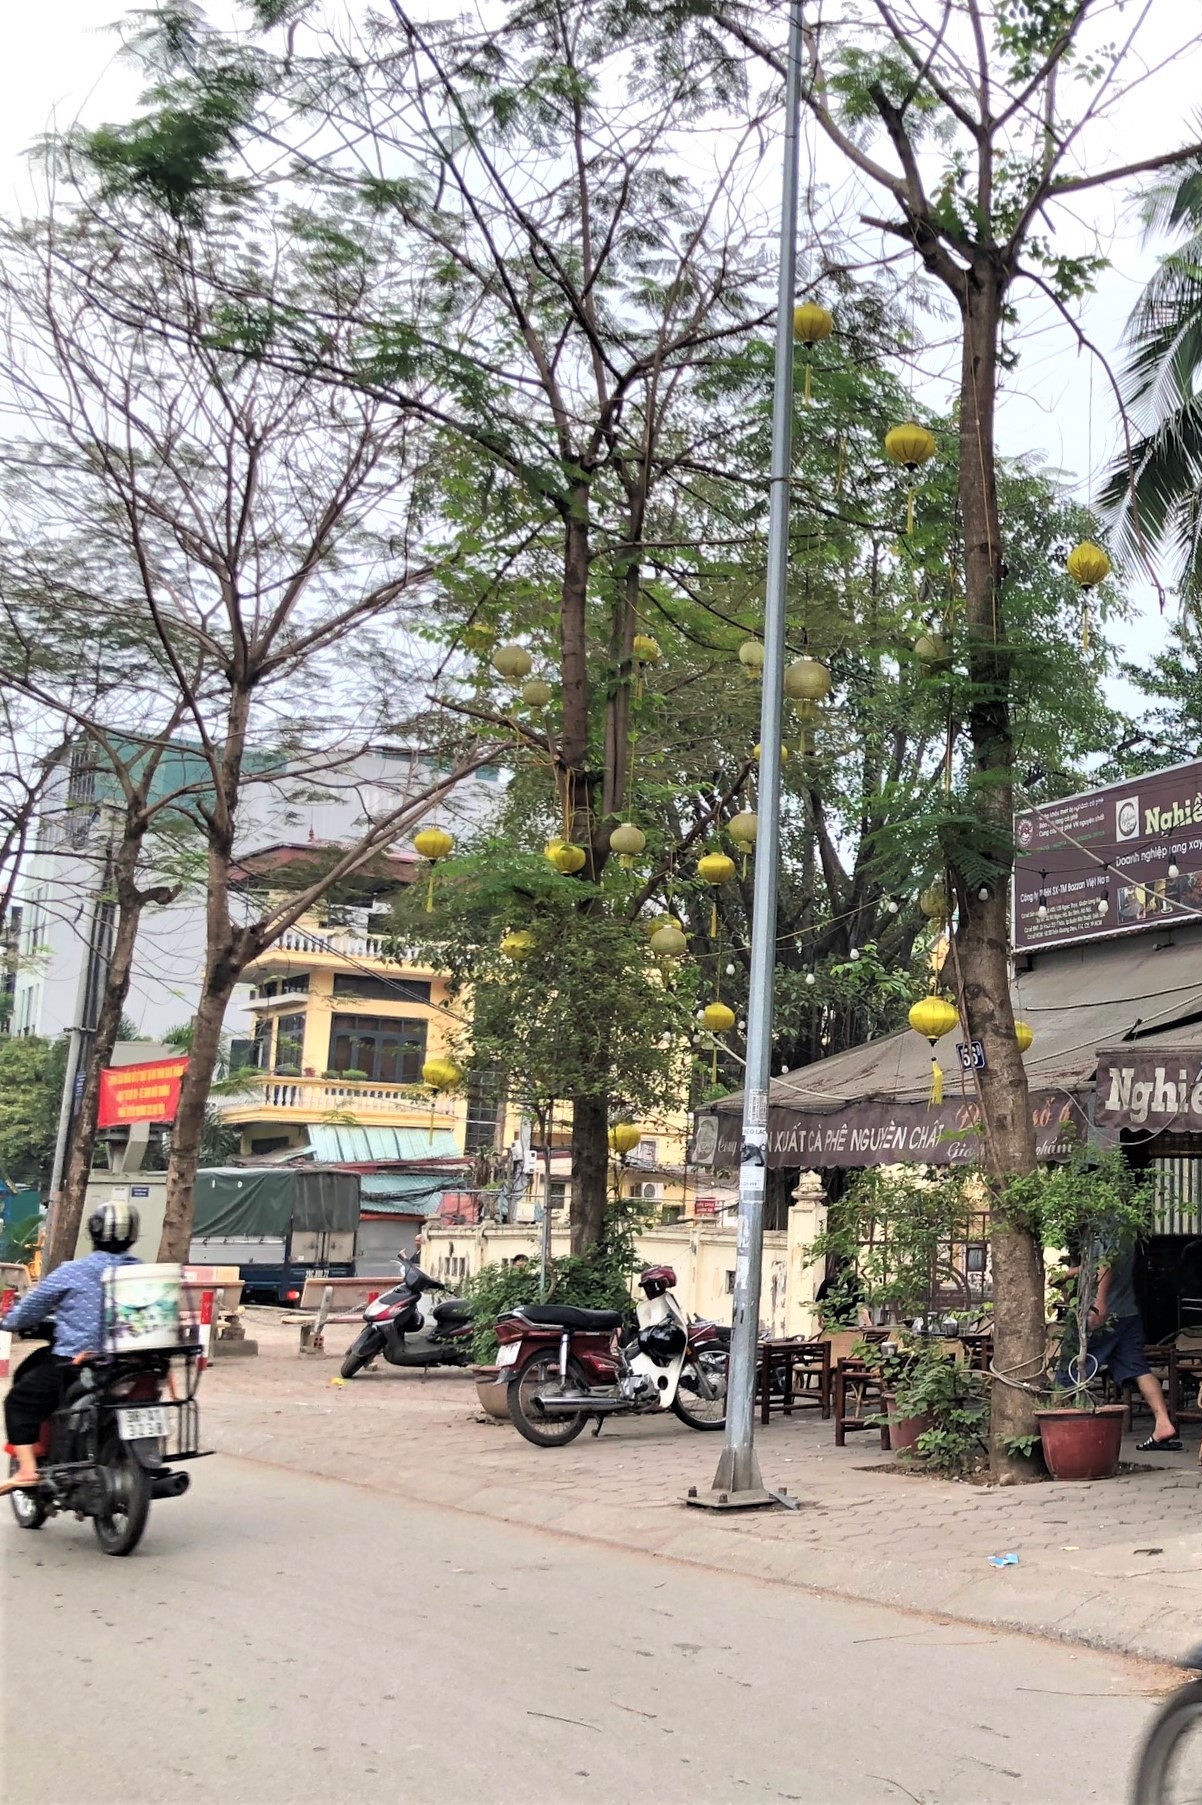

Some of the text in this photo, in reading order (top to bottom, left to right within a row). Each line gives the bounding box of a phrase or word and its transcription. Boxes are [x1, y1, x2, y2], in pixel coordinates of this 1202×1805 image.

[808, 1124, 822, 1152] CÀ
[824, 1123, 848, 1151] PHÊ
[850, 1120, 907, 1151] NGUYÊN
